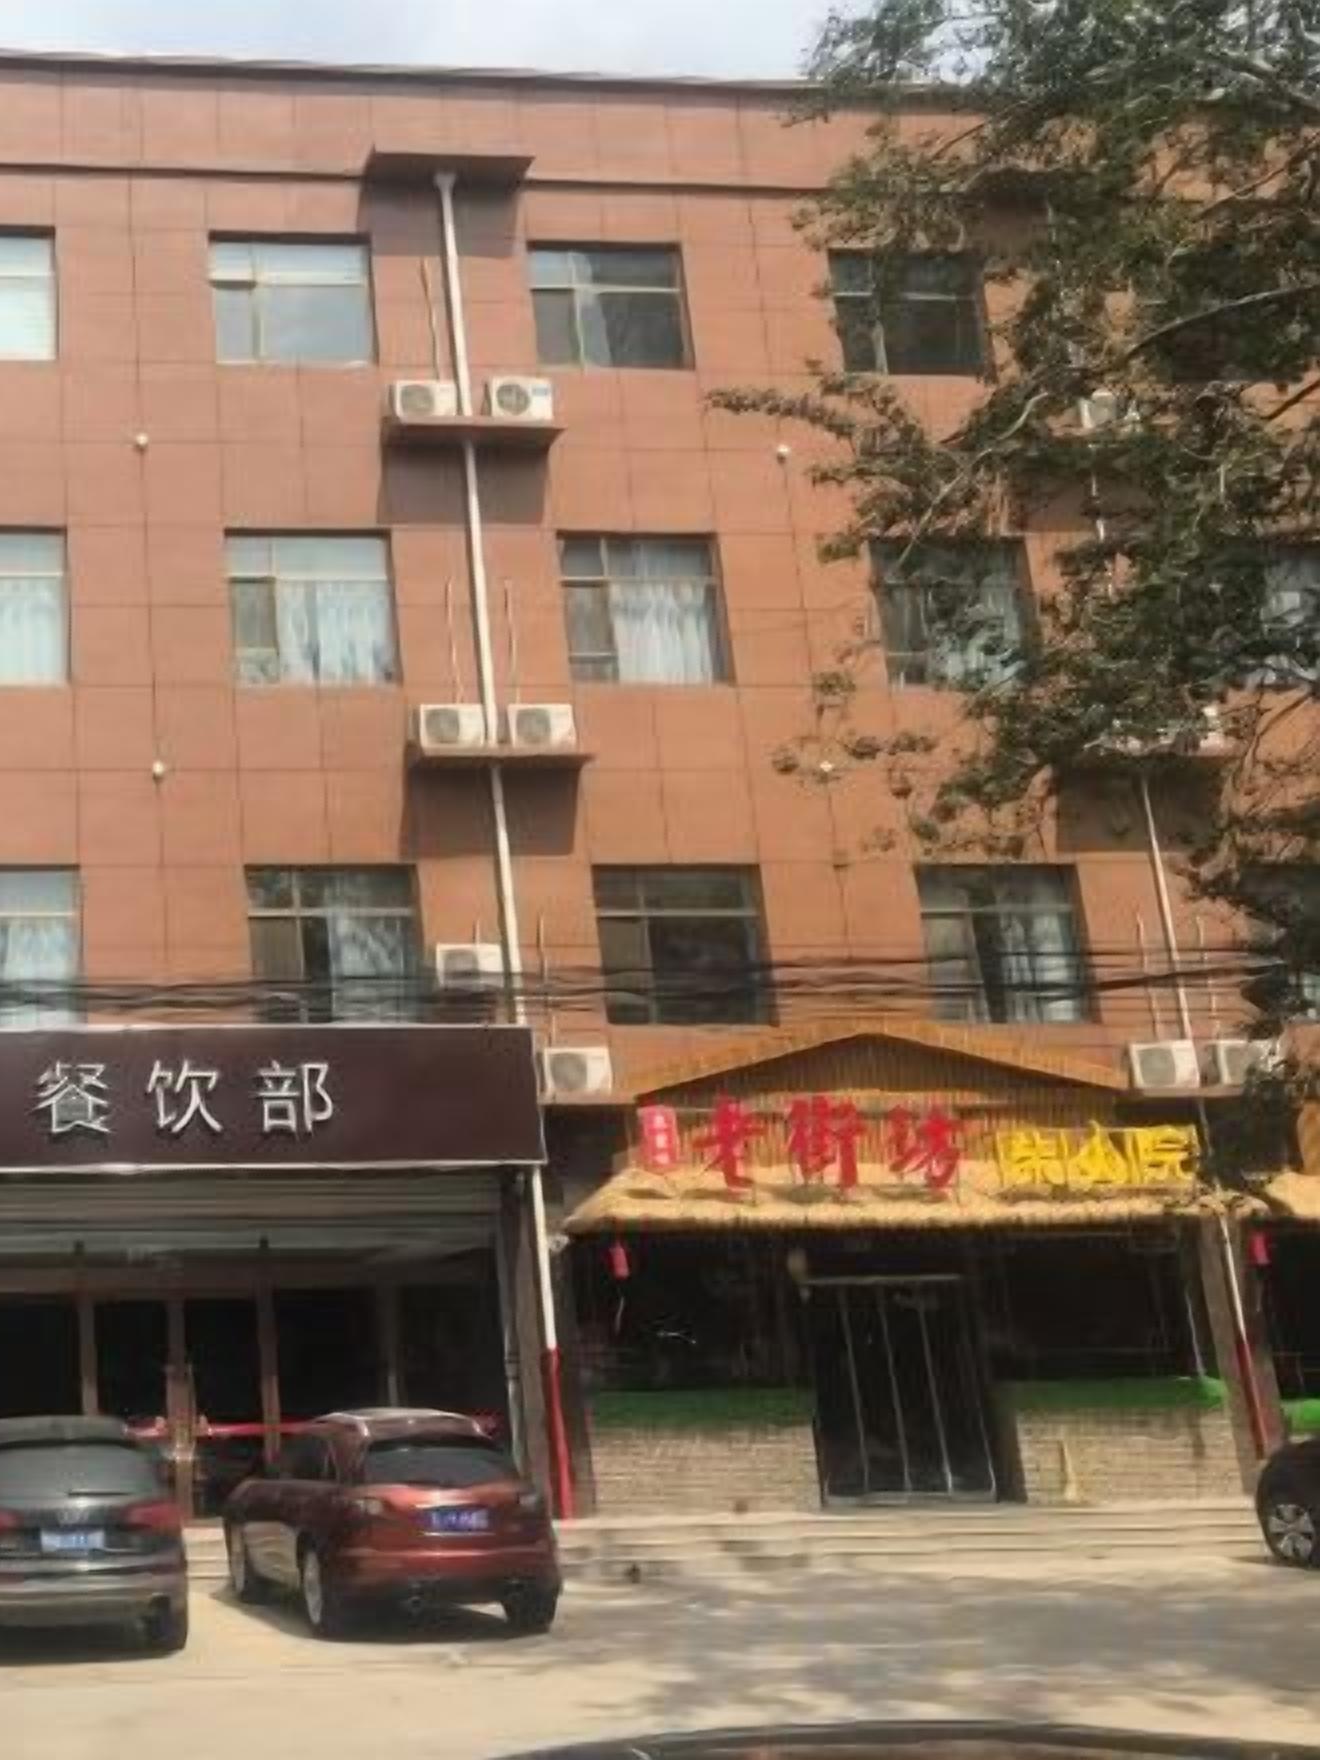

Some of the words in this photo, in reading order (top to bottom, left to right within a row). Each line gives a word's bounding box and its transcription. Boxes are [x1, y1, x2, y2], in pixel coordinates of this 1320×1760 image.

[30, 1060, 334, 1135] 餐饮部
[692, 1095, 961, 1188] 老街坊
